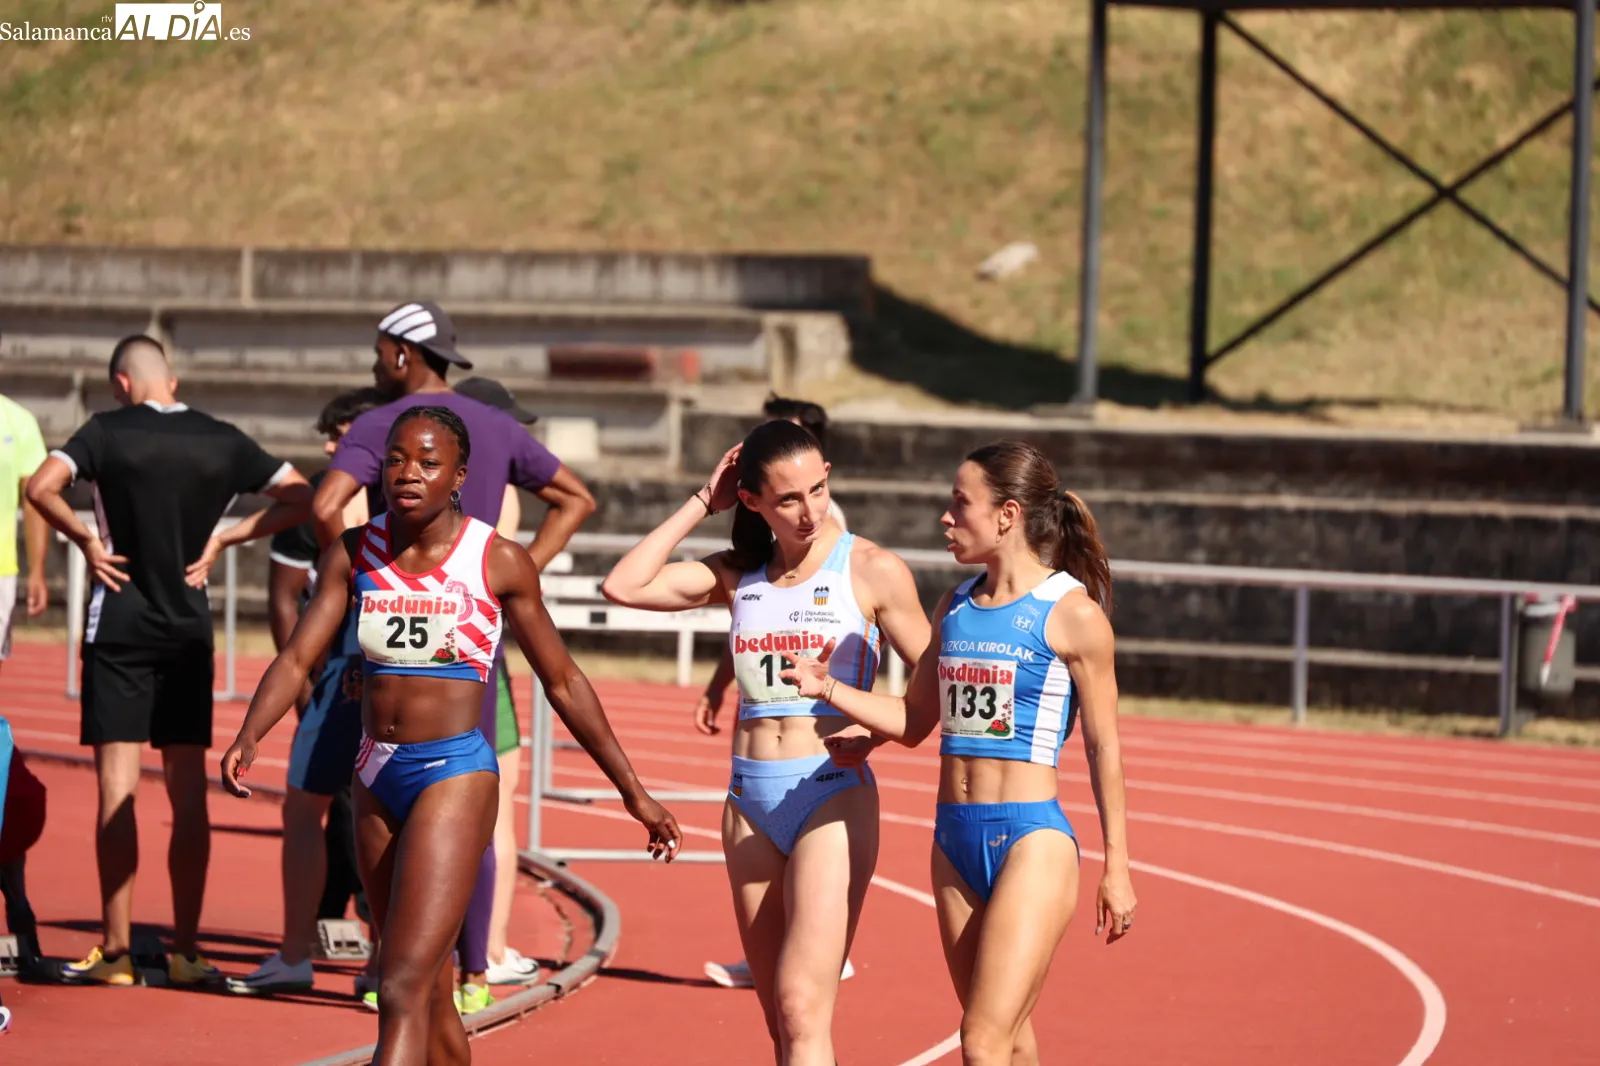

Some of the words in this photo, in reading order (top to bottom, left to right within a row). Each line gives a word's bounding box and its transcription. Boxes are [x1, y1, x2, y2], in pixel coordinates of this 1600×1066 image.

[363, 595, 457, 615] bedunia
[386, 616, 429, 649] 25
[735, 630, 825, 654] bedunia
[977, 641, 1034, 661] KIROLAK
[940, 663, 1013, 685] bedunia
[947, 684, 997, 720] 133
